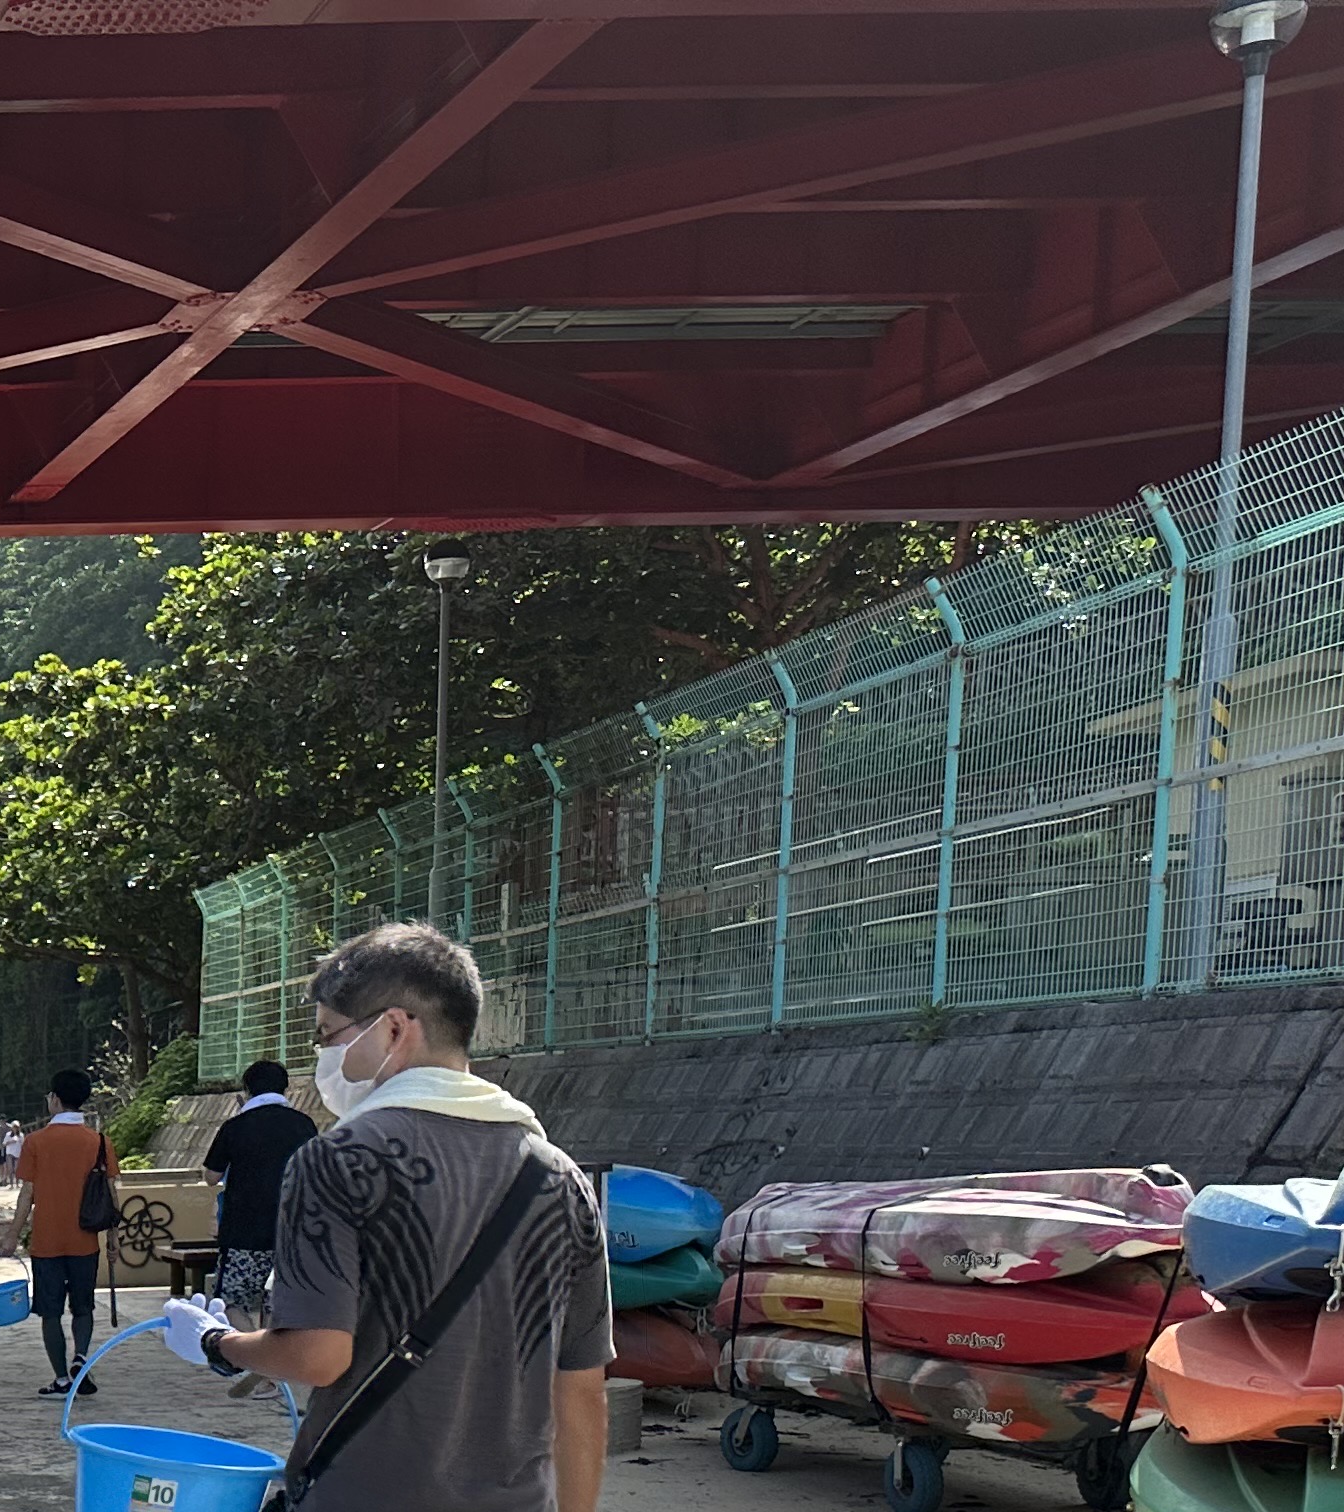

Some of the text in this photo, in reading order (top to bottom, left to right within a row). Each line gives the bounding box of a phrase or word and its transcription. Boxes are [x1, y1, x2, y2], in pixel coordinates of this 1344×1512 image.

[943, 1251, 1002, 1269] feelfree
[947, 1332, 1005, 1350] feelfree
[953, 1407, 1013, 1426] feelfree
[152, 1485, 174, 1504] 10
